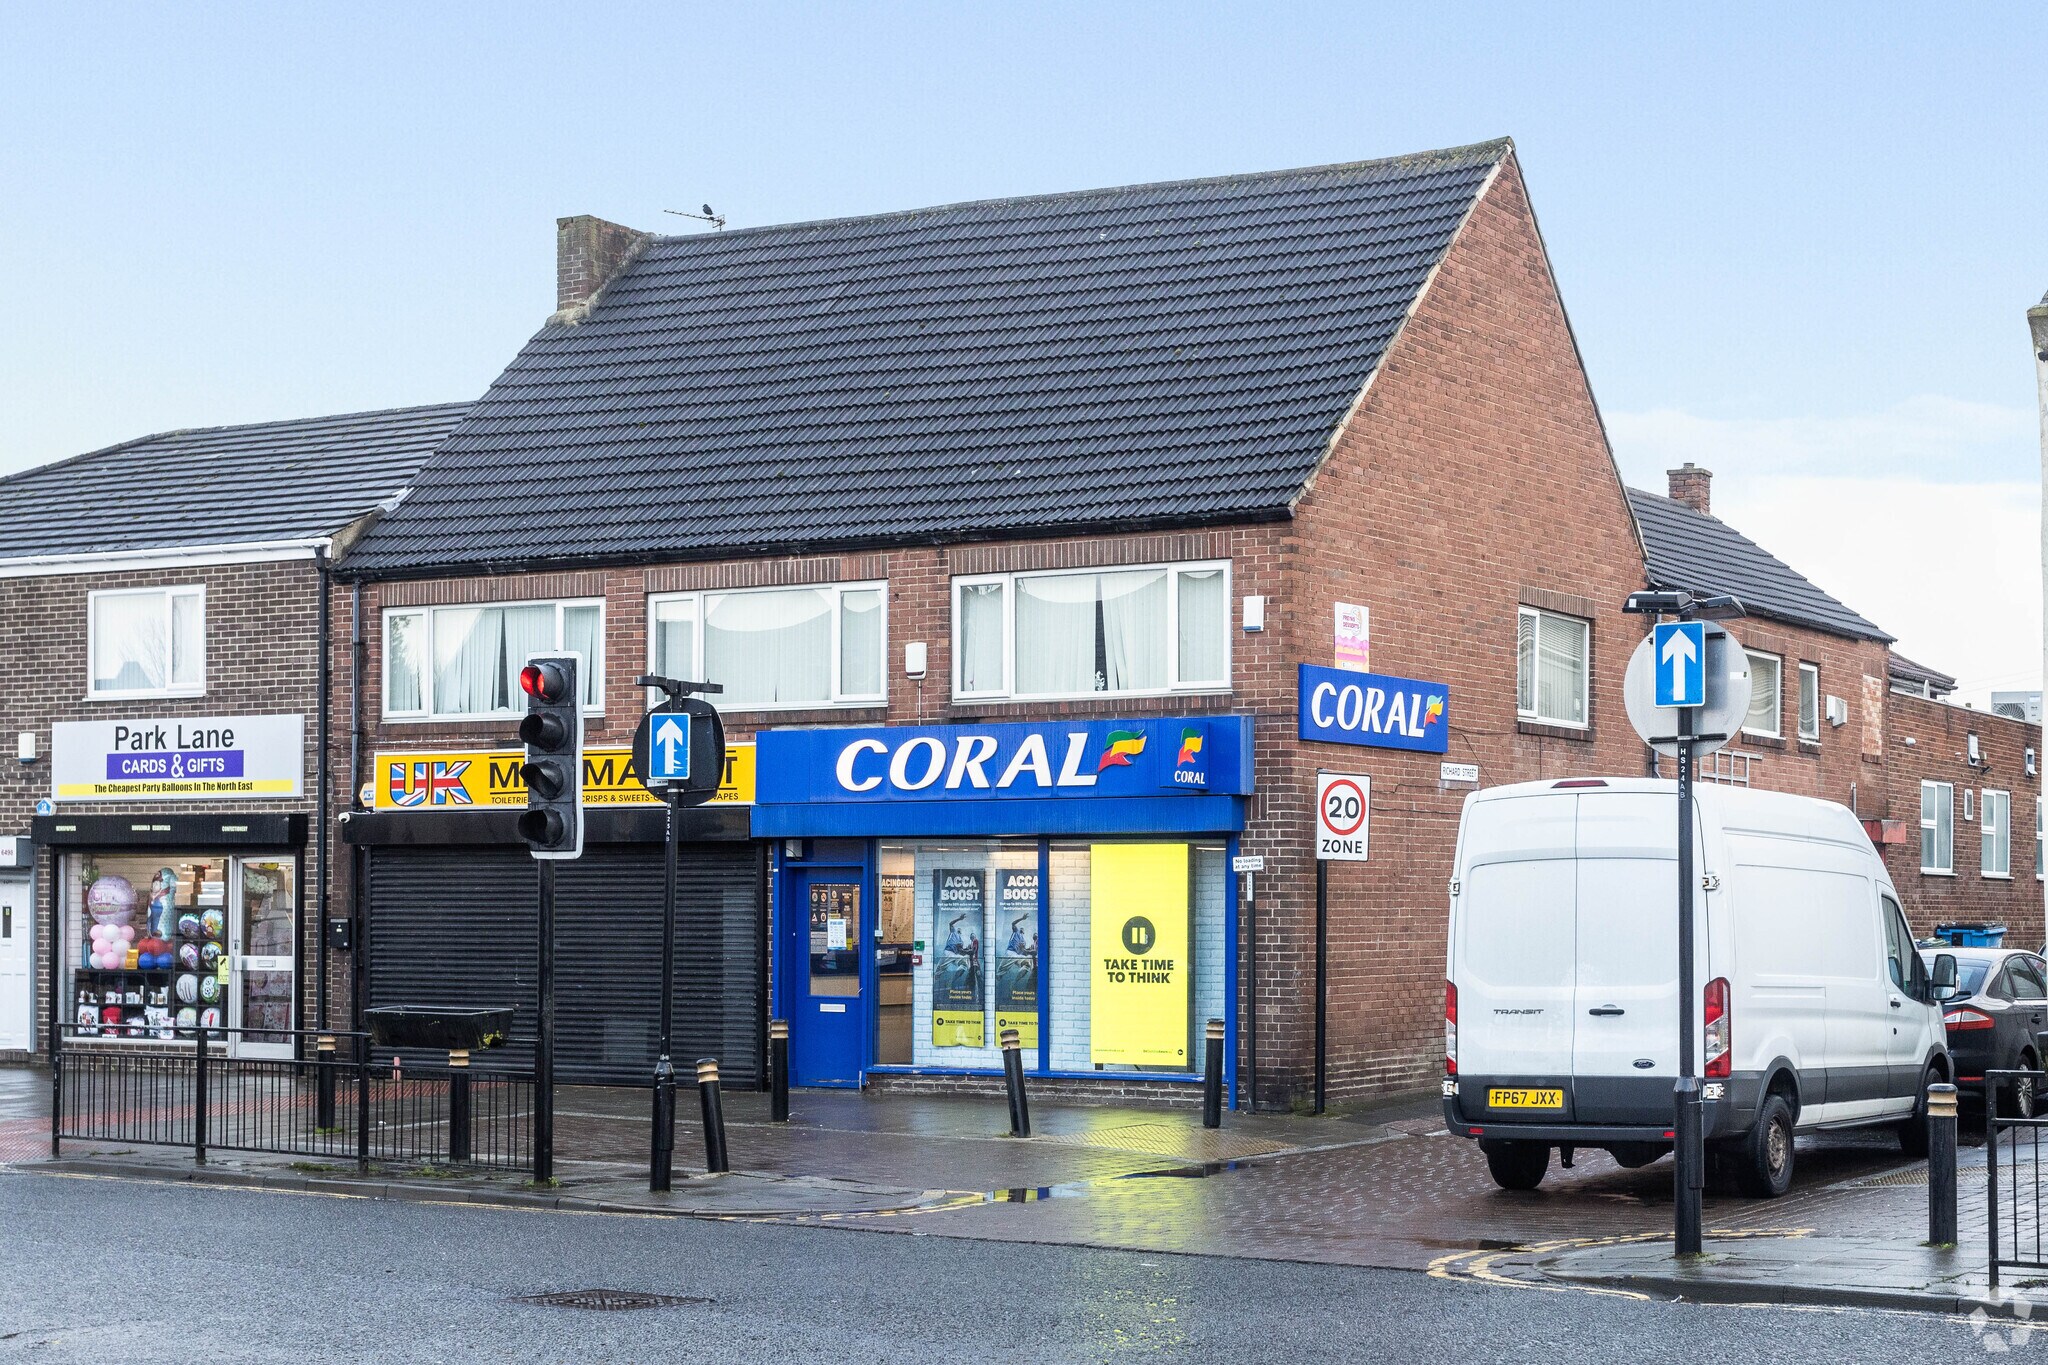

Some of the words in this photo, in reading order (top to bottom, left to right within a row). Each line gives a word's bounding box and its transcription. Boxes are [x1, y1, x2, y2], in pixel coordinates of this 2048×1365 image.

[1311, 681, 1426, 738] CORAL
[115, 725, 167, 751] Park
[177, 724, 234, 749] Lane
[121, 758, 167, 774] CARDS
[170, 753, 185, 778] &
[187, 757, 225, 773] GIFTS
[835, 732, 1098, 791] CORAL
[583, 756, 738, 786] MAT
[1174, 770, 1206, 785] CORAL
[94, 784, 107, 793] The
[108, 783, 141, 794] Cheapest
[142, 783, 160, 793] Party
[162, 782, 193, 792] Balloons
[194, 782, 201, 791] In
[202, 782, 216, 791] The
[217, 782, 237, 791] North
[238, 781, 253, 791] East
[389, 760, 473, 807] UK
[491, 796, 528, 804] TOILETRIE
[1329, 796, 1360, 819] 20
[1322, 839, 1363, 854] ZONE
[944, 876, 977, 888] ACCA
[1007, 875, 1038, 887] ACCA
[941, 889, 980, 901] BOOST
[1103, 959, 1138, 970] TAKE
[1141, 959, 1174, 971] TIME
[1107, 972, 1126, 983] TO
[1130, 972, 1171, 984] THINK
[1495, 1091, 1528, 1105] FP67
[1531, 1091, 1556, 1105] JXX
